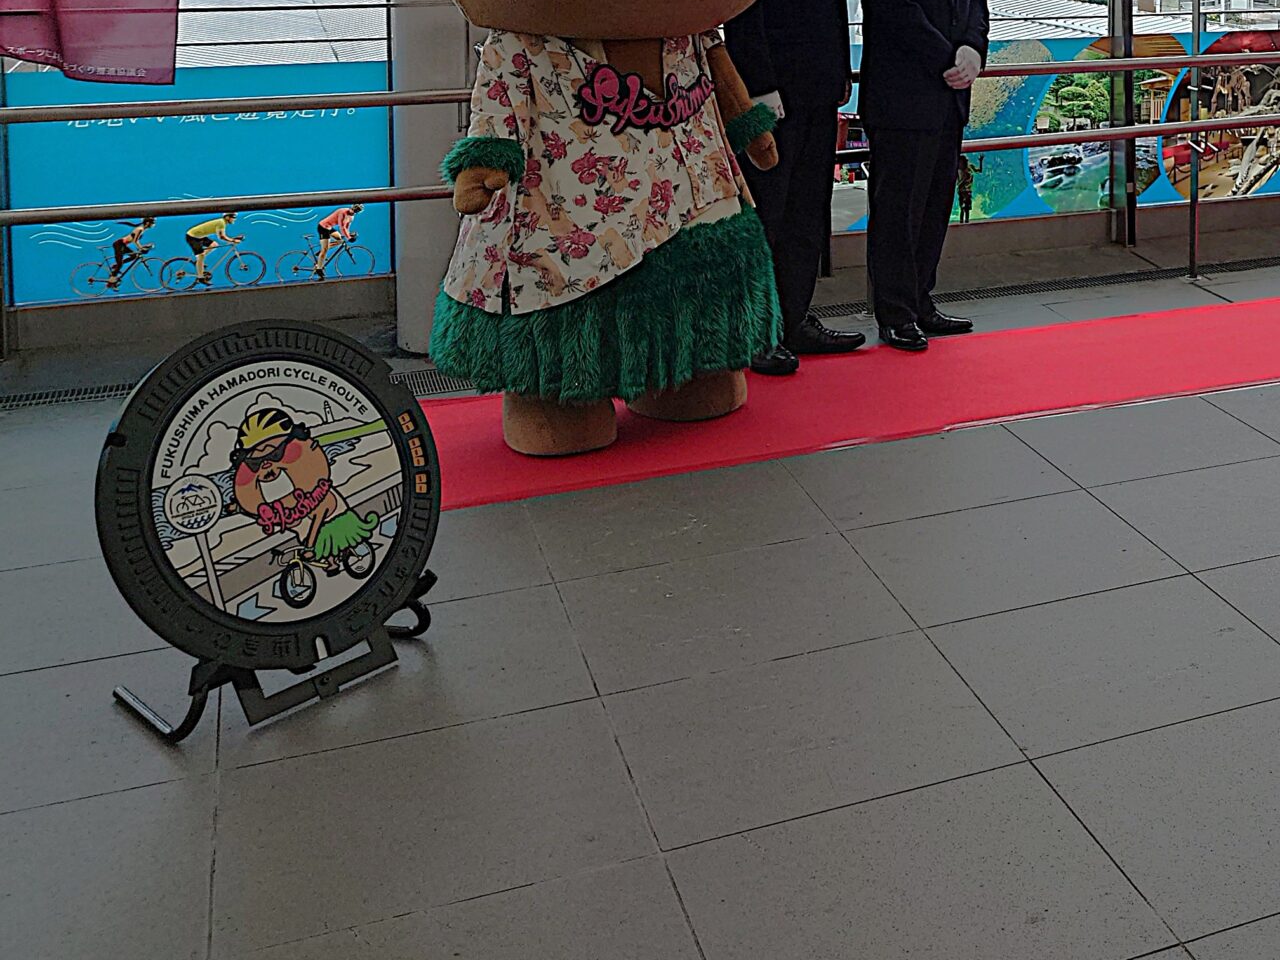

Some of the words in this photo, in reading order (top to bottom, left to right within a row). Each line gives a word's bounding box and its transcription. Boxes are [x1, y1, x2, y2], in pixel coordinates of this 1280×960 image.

[160, 398, 210, 480] FUKUSHIMA
[207, 366, 281, 401] HAMADORI
[282, 366, 328, 387] CYCLE
[327, 380, 370, 416] ROUTE
